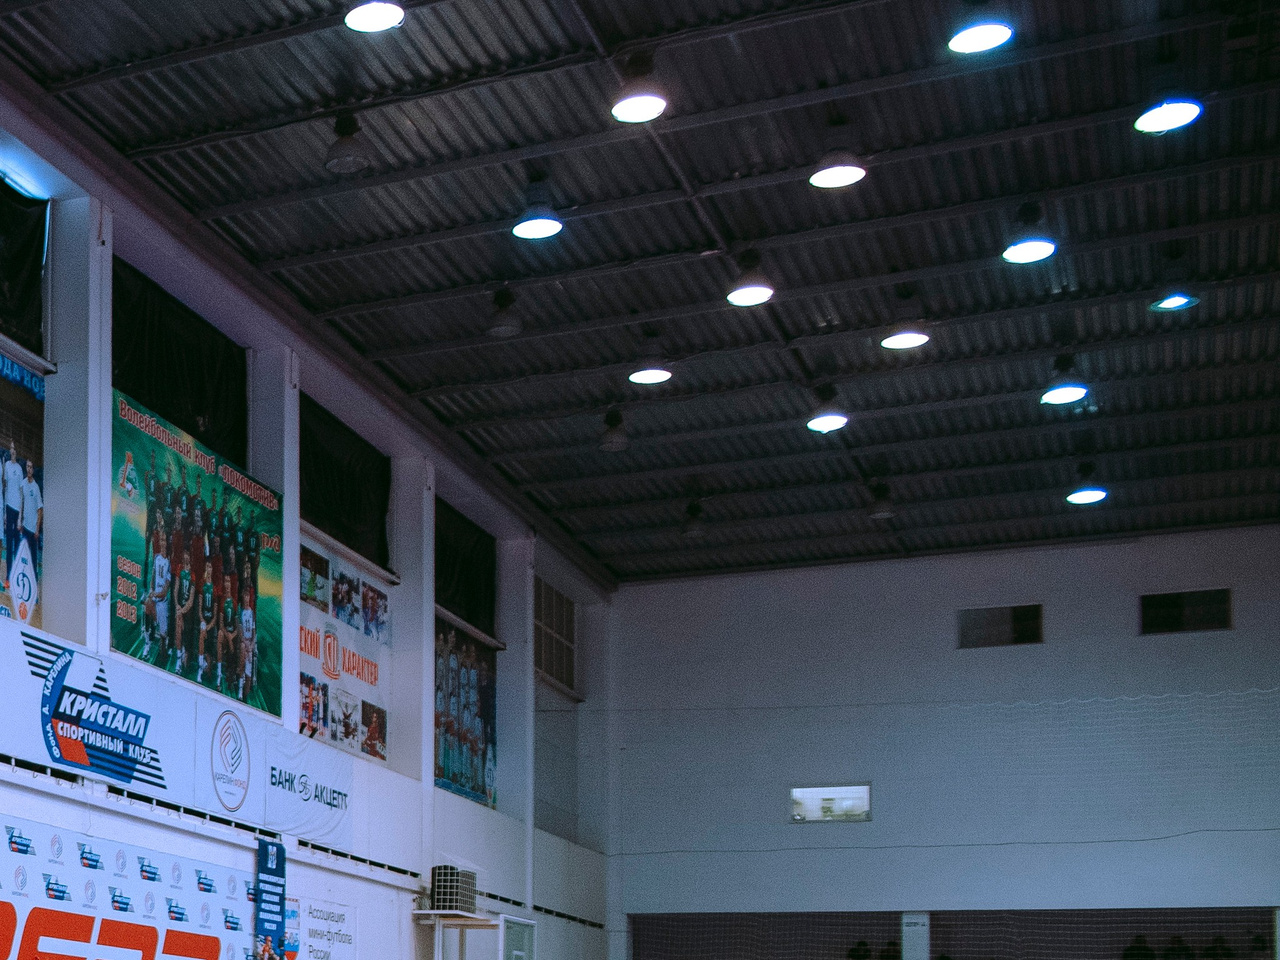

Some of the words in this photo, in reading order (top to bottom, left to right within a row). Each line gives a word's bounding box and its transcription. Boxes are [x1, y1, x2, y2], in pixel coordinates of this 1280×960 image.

[342, 646, 379, 686] ХАРАКТЕР
[59, 690, 147, 739] КРИСТАЛЛ
[57, 721, 123, 754] СПОРТИВНЫЙ
[129, 743, 151, 763] КЛУБ
[271, 766, 297, 793] БАНК
[314, 783, 348, 811] АКЦЕПТ
[309, 904, 345, 923] Ассоциация
[309, 928, 352, 945] мини-футбола
[309, 945, 331, 960] России
